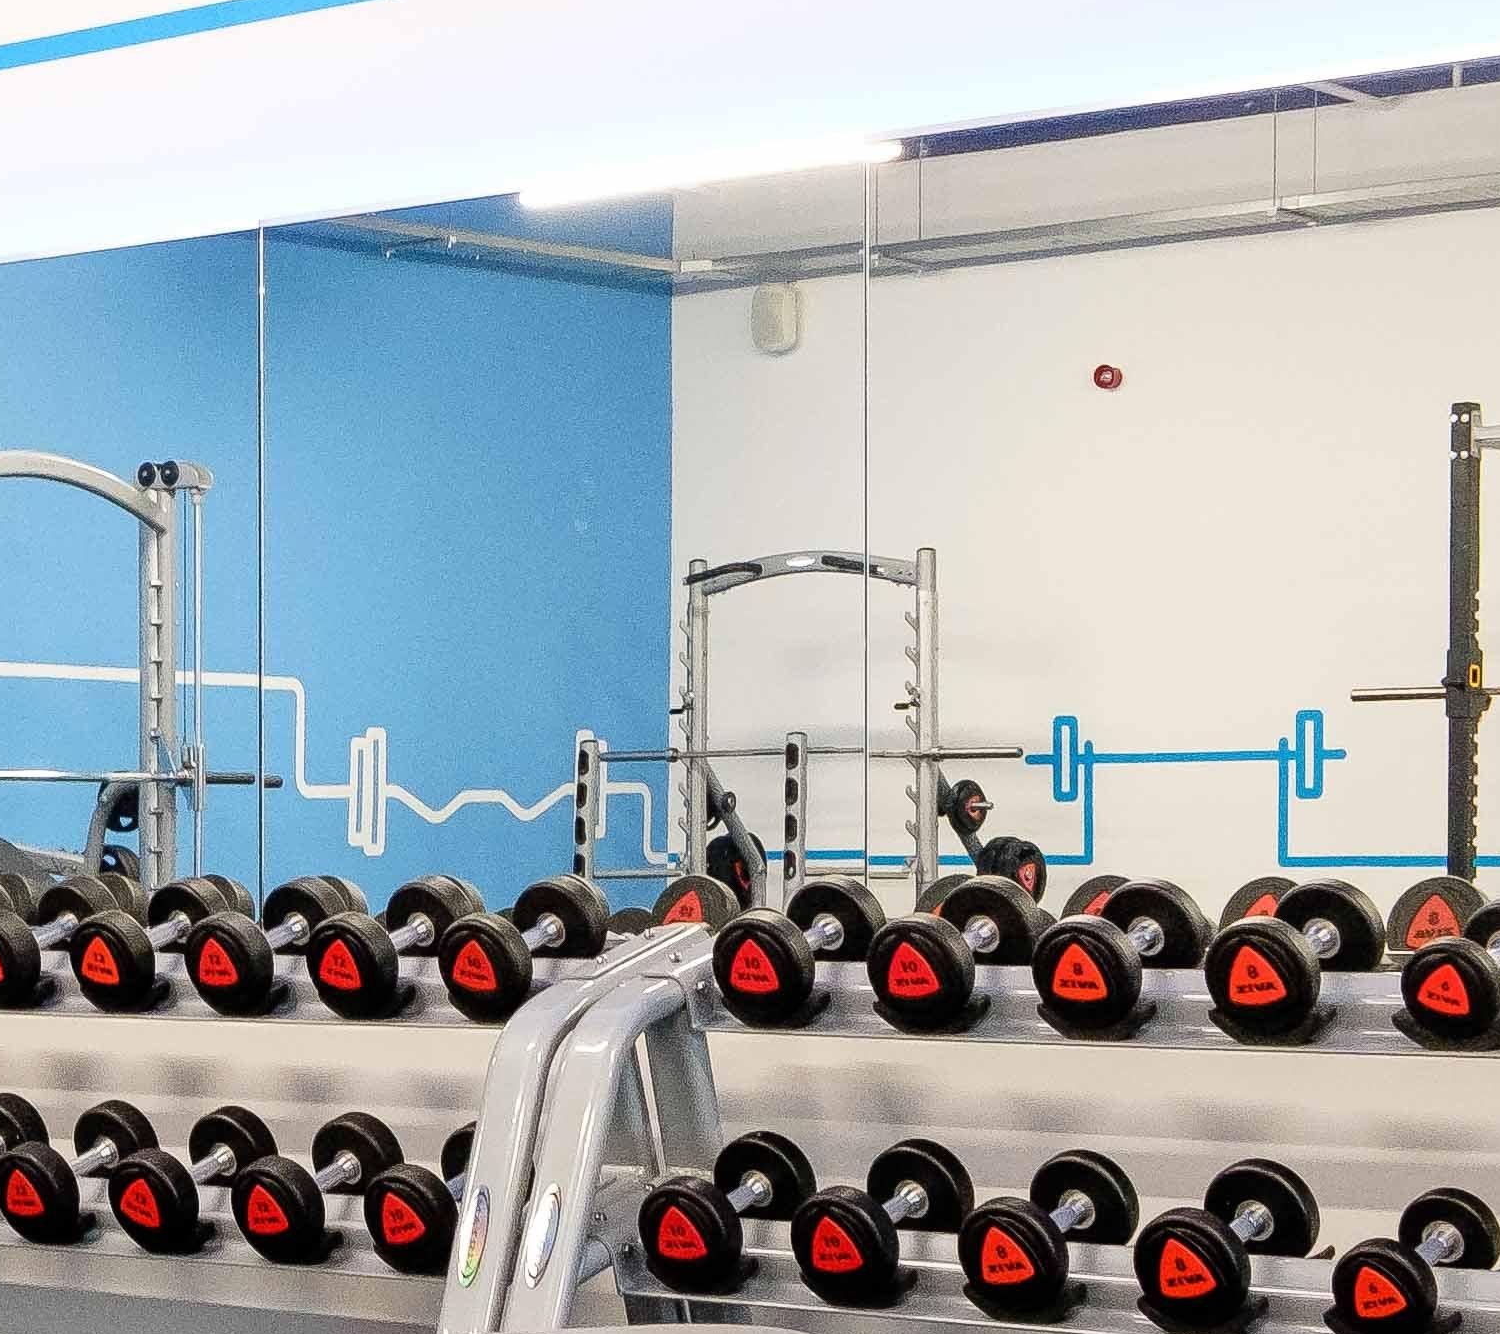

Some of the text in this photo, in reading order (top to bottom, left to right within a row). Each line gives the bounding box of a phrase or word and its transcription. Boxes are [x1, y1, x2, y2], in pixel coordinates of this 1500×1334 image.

[743, 957, 760, 969] 10
[901, 960, 917, 973] 10
[1073, 962, 1083, 975] 8
[1247, 964, 1259, 979] 8
[1059, 979, 1099, 989] ZIVA
[1236, 982, 1278, 994] ZIVA
[1441, 981, 1450, 991] 6
[1166, 1274, 1205, 1287] ZIVA
[1368, 1282, 1378, 1294] 6
